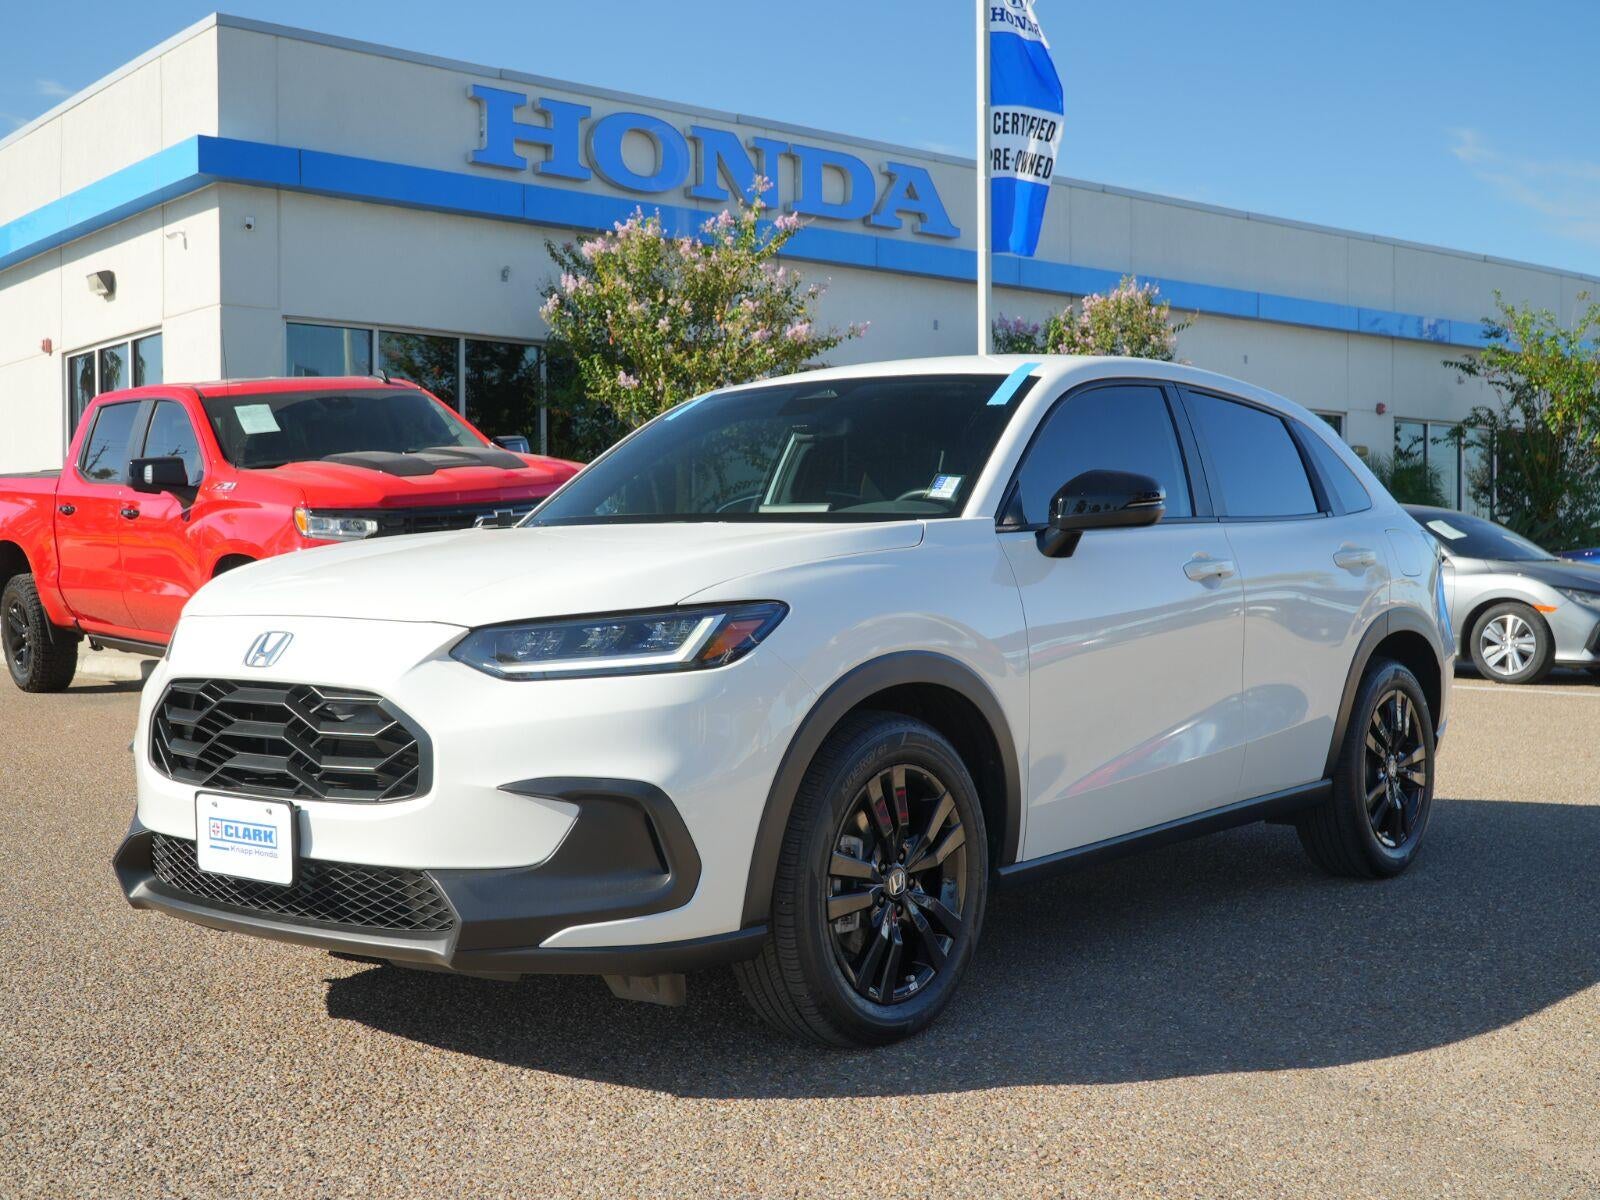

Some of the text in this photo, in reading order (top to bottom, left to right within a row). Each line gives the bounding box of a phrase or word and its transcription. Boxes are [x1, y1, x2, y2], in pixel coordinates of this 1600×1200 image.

[993, 112, 1057, 142] CERTIFIED
[467, 84, 960, 239] HONDA
[224, 824, 274, 843] CLARK
[230, 845, 278, 859] Knapp Honda
